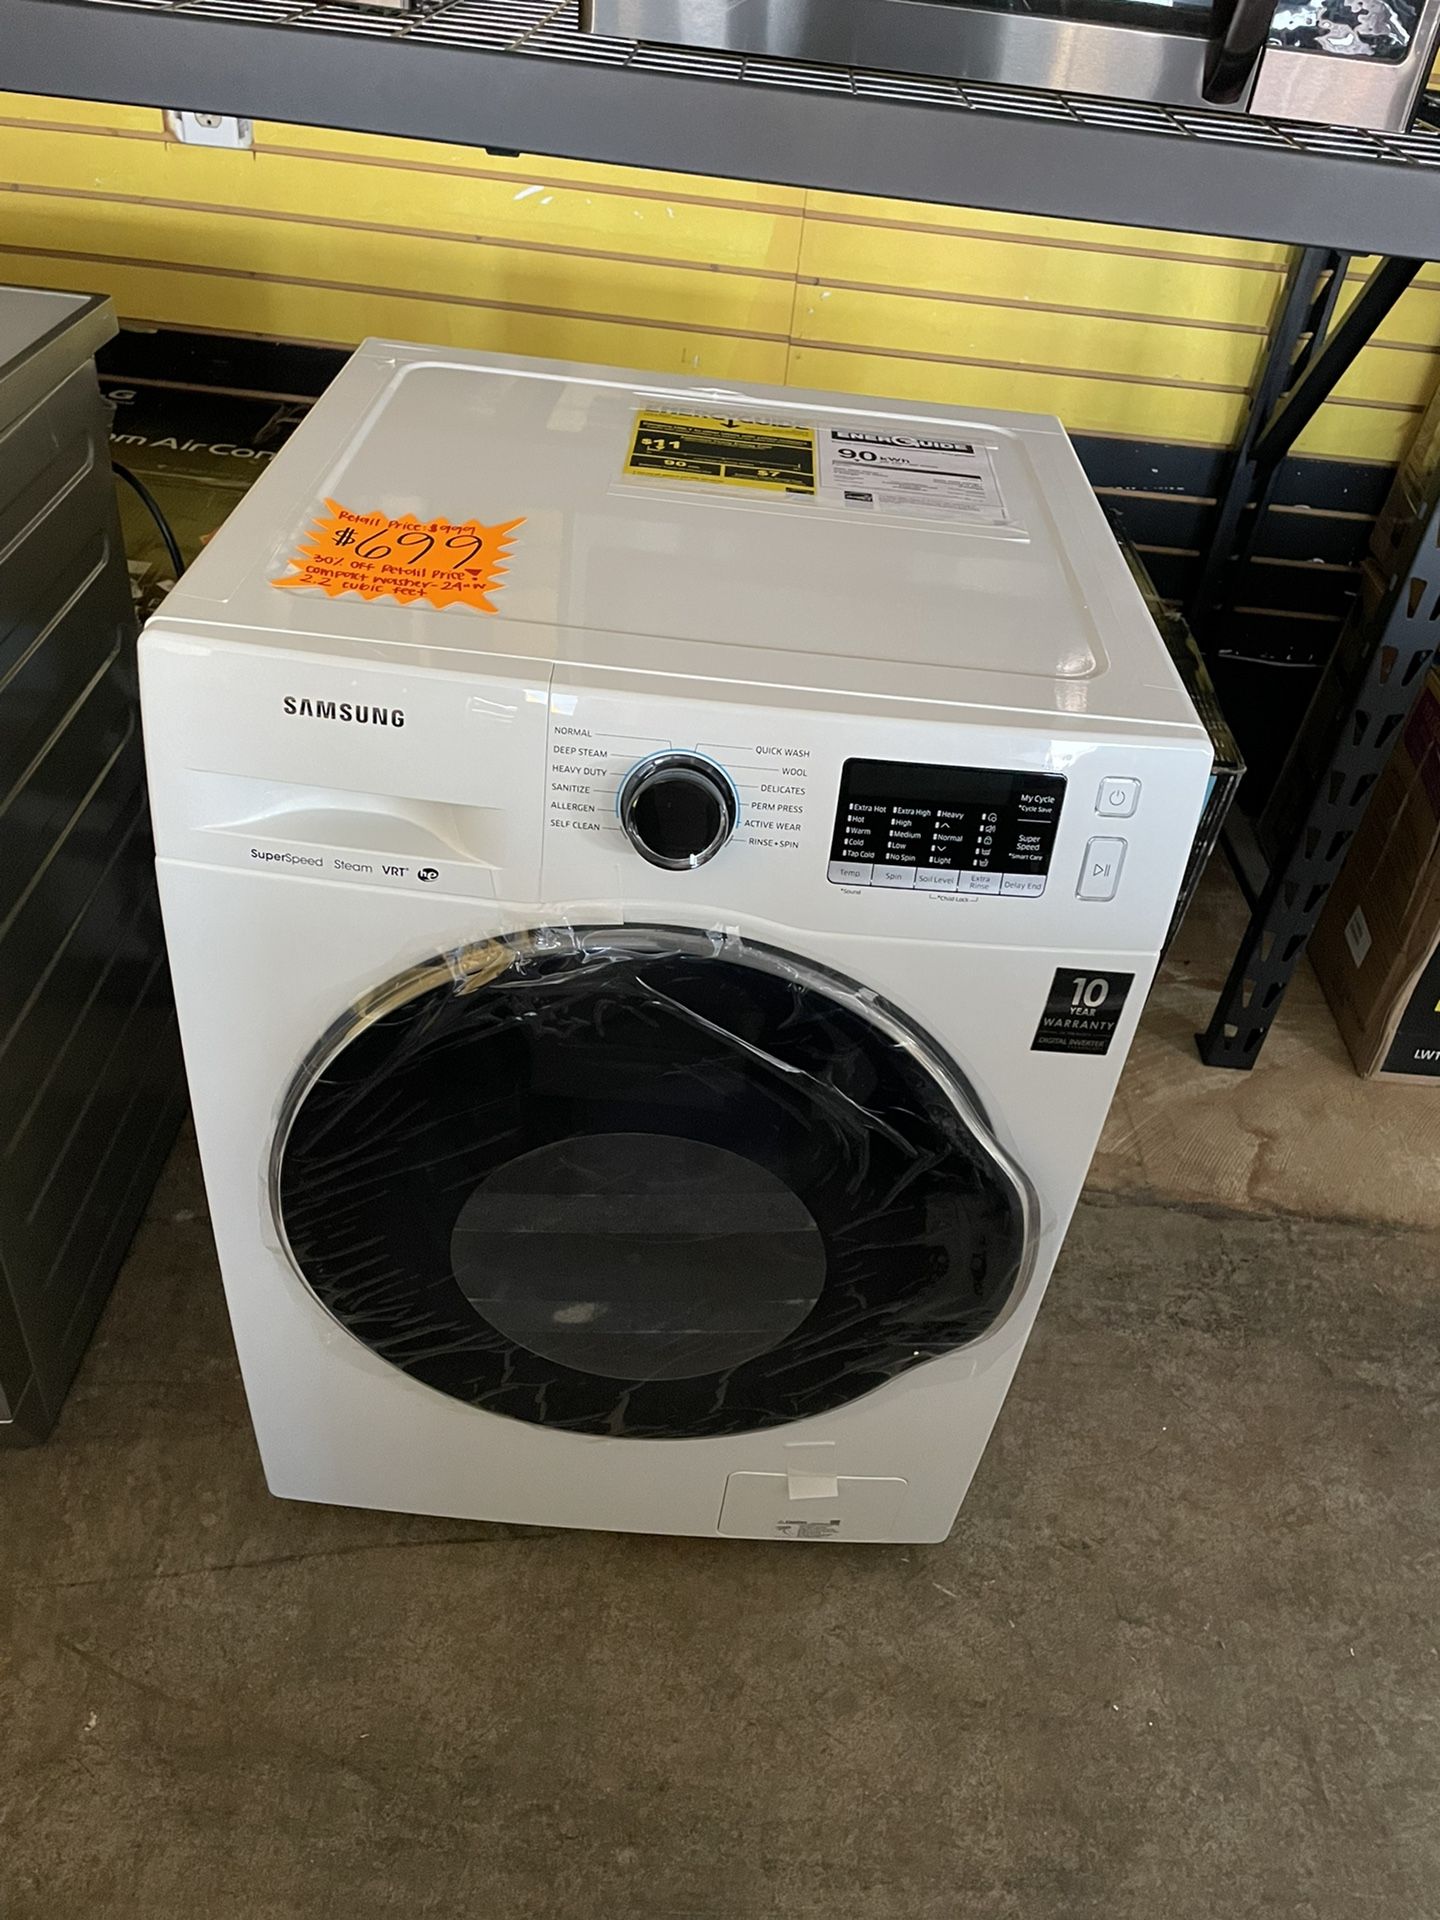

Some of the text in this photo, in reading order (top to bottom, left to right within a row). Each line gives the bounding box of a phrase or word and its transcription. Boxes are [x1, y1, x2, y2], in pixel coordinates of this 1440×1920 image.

[331, 526, 483, 570] $699
[313, 553, 345, 566] 30%
[299, 574, 428, 597] 2.2 cubic feet
[283, 696, 405, 728] SAMSUNG
[554, 726, 592, 738] NORMAL
[553, 745, 608, 758] DEEP STEAM
[755, 745, 810, 758] QUICK WASH
[552, 764, 607, 776] HEAVY DUTY
[782, 767, 808, 777] WOOL
[551, 782, 590, 794] SANITIZE
[760, 784, 806, 796] DELICATES
[1020, 794, 1056, 804] My Cycle
[550, 801, 595, 812] ALLERGEN
[751, 801, 804, 814] PERM PRESS
[854, 803, 887, 813] Extra Hot
[897, 807, 931, 817] Extra High
[941, 811, 964, 820] Heavy
[852, 815, 865, 823] Hot
[895, 819, 912, 828] High
[550, 818, 600, 831] SELF CLEAN
[744, 819, 802, 831] ACTIVE WEAR
[850, 827, 871, 835] Warm
[893, 830, 921, 839] Medium
[938, 834, 963, 842] Normal
[1018, 834, 1041, 844] Super
[892, 841, 906, 849] Low
[1016, 843, 1040, 852] Speed
[847, 850, 875, 858] Tap Cold
[889, 853, 916, 862] No Spin
[250, 848, 324, 867] SuperSpeed
[333, 859, 373, 873] Steam
[933, 856, 951, 865] Light
[840, 869, 861, 878] Temp
[885, 872, 902, 880] Spin
[919, 874, 955, 885] Soil Level
[969, 882, 990, 890] Rinse
[1004, 881, 1042, 891] Delay End
[1071, 977, 1110, 1008] 10
[1069, 1007, 1097, 1017] YEAR
[1042, 1017, 1115, 1031] WARRANTY
